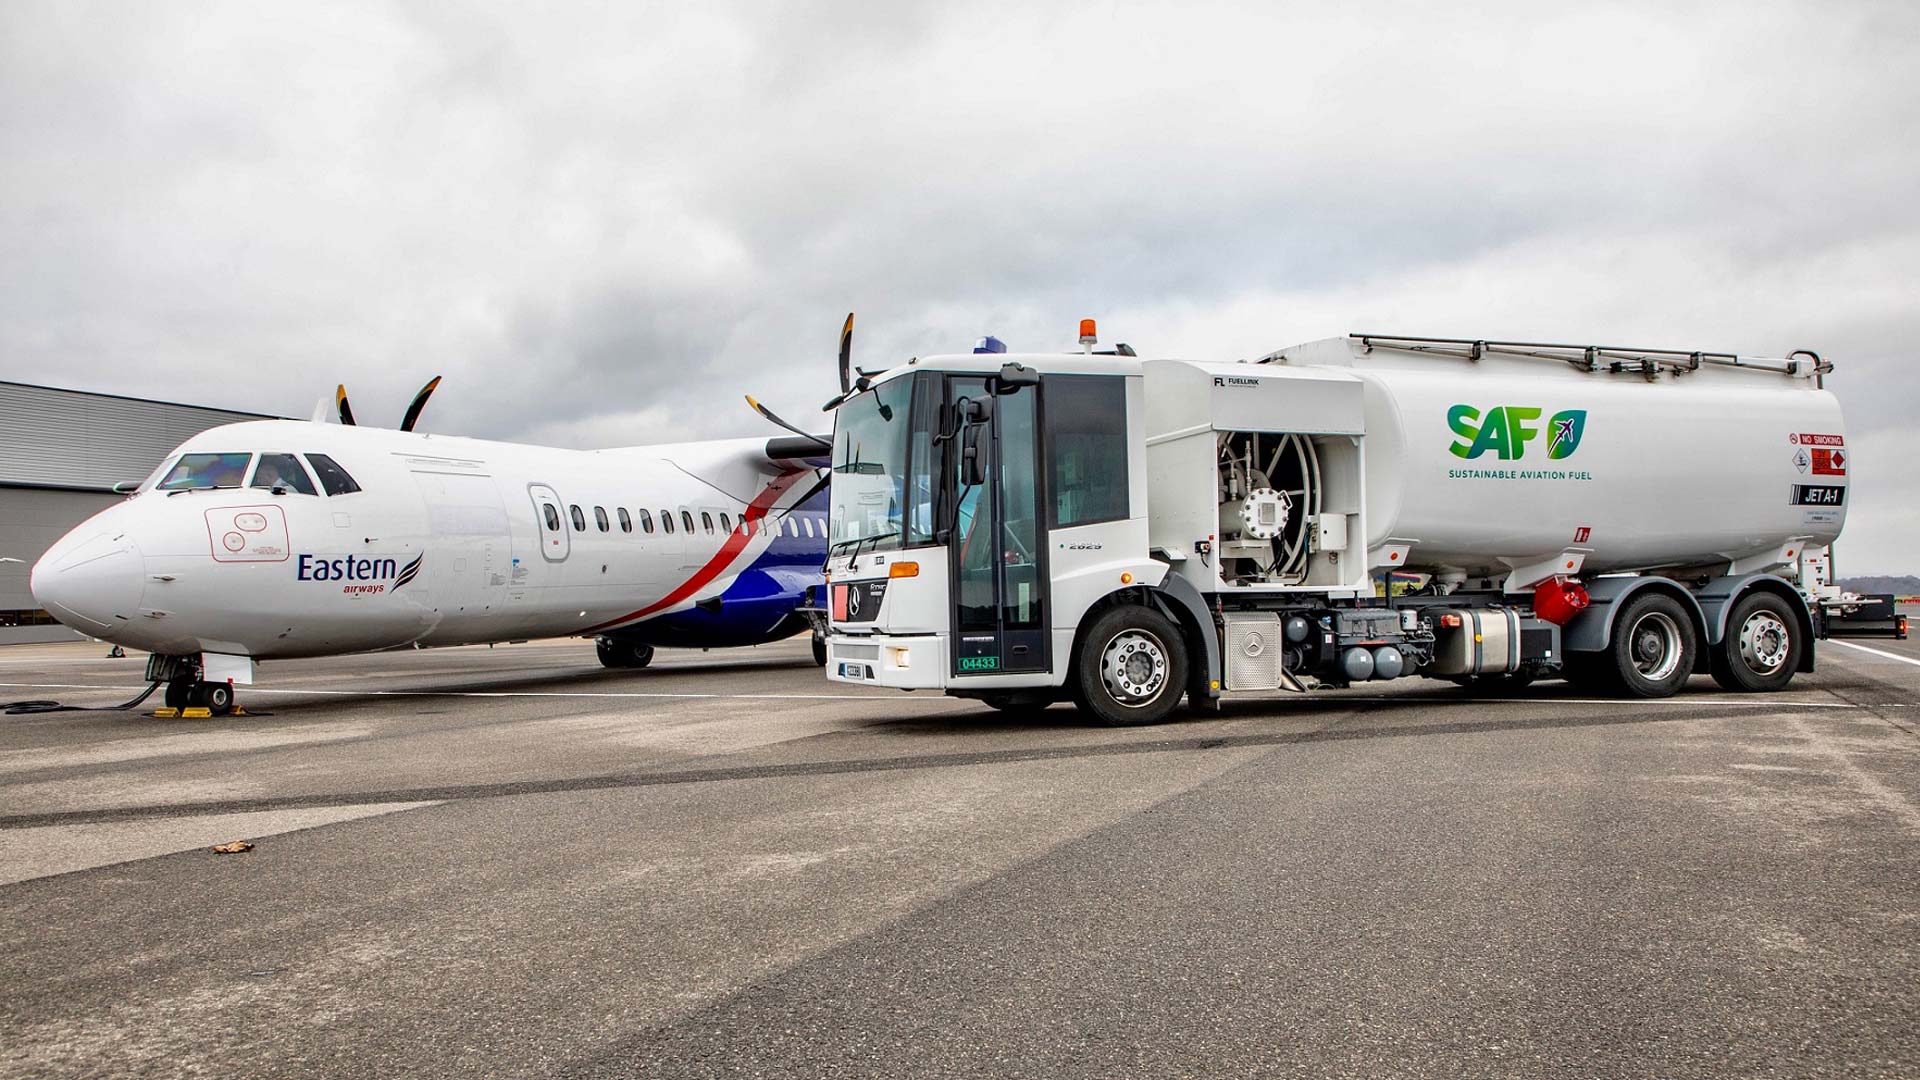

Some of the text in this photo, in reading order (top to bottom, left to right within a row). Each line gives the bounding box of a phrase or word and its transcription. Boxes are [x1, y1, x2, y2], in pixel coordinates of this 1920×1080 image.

[1228, 377, 1259, 385] FUELLINK
[1447, 404, 1542, 460] SAF
[1802, 435, 1842, 445] NO SMOKING
[1448, 469, 1592, 480] SUSTAINABLE AVIATION FUEL
[1805, 488, 1838, 503] JET A-1
[297, 553, 397, 581] Eastern
[343, 583, 385, 594] airways
[962, 658, 995, 669] 04433
